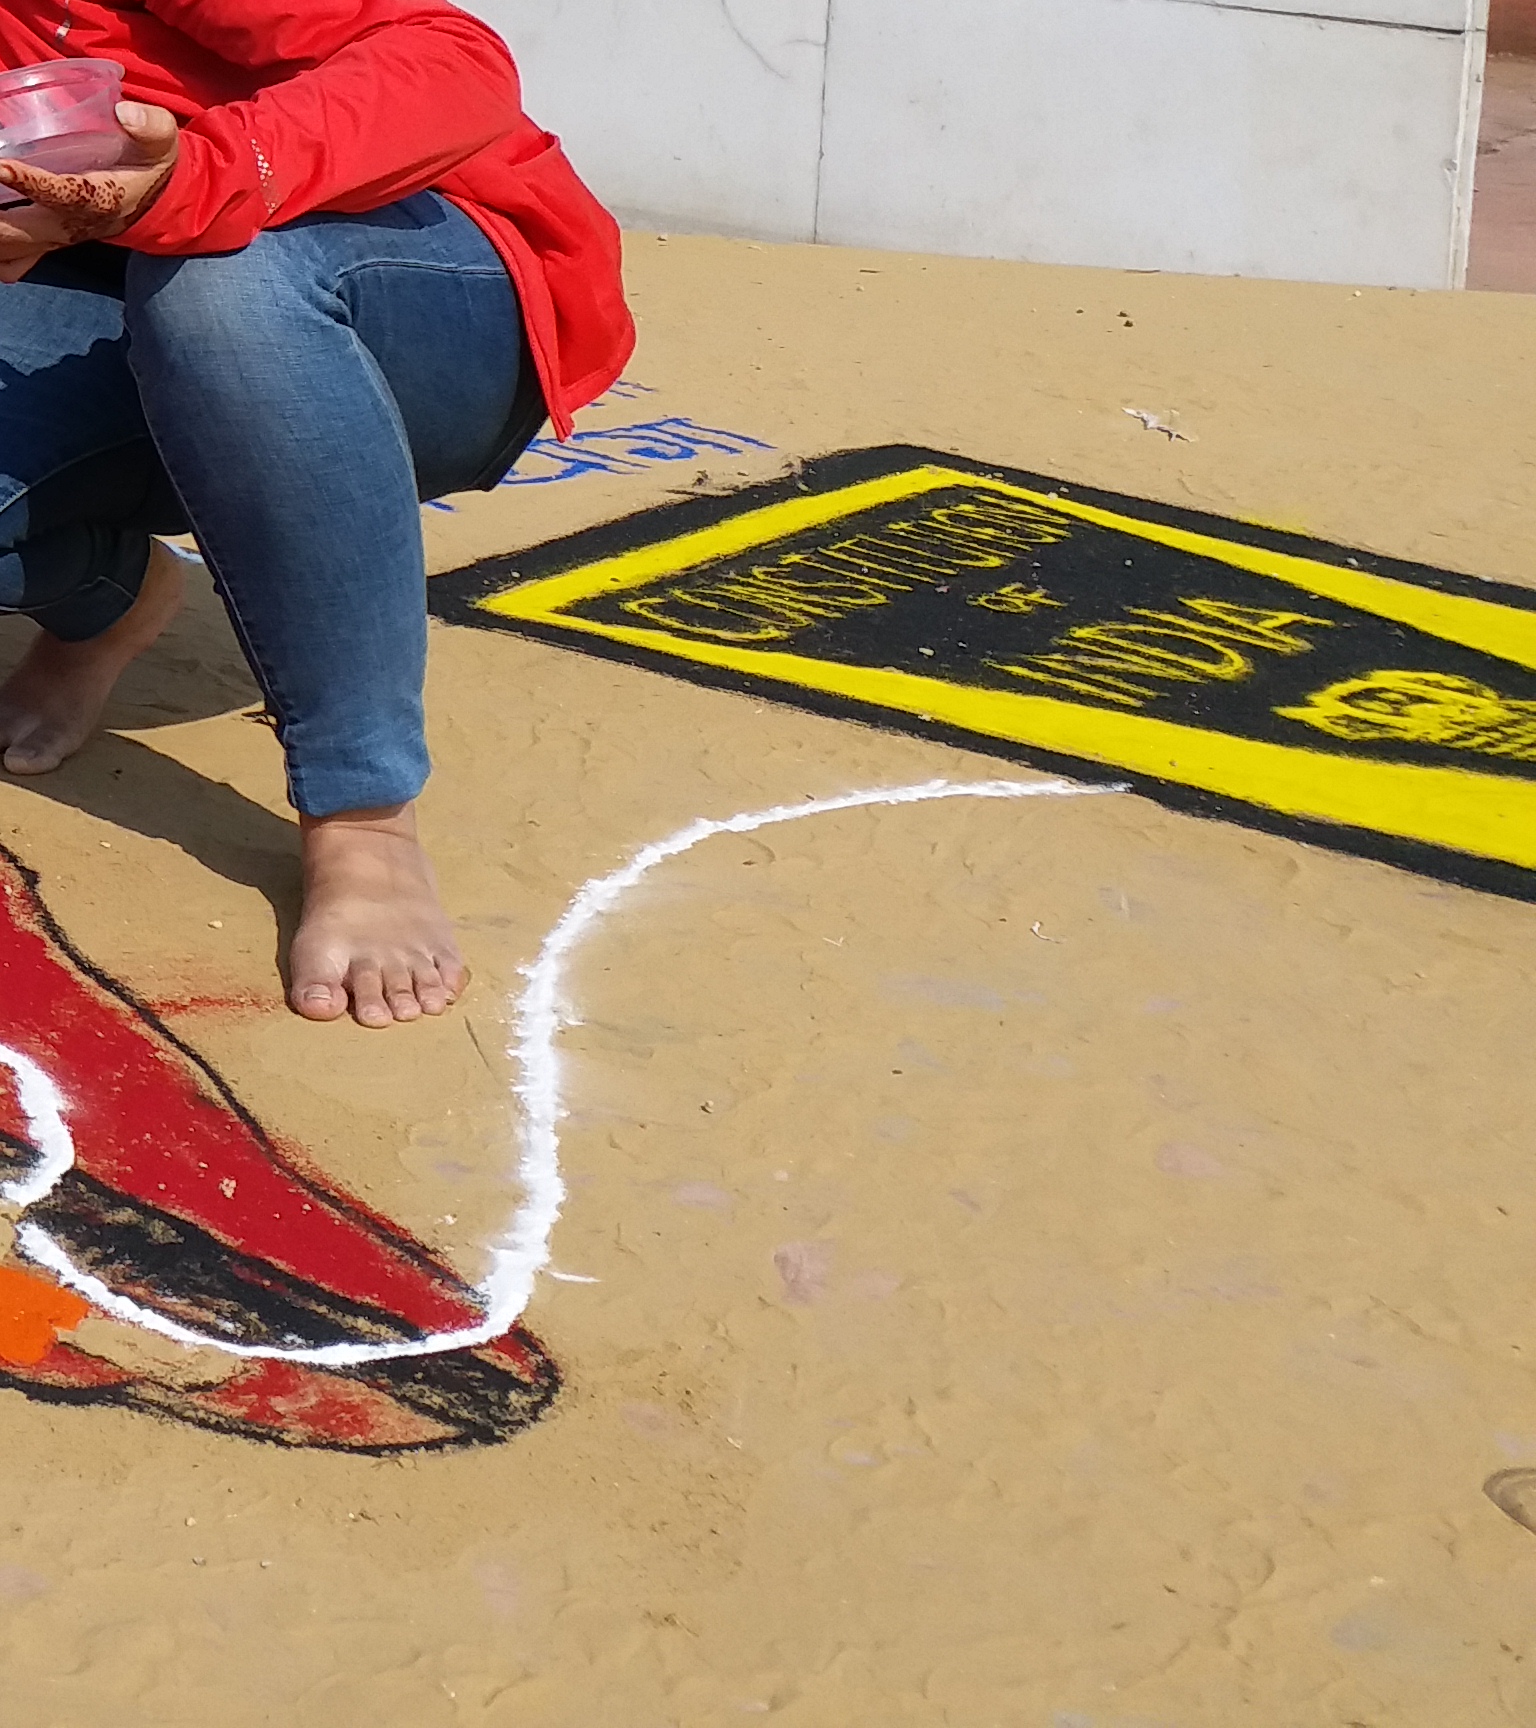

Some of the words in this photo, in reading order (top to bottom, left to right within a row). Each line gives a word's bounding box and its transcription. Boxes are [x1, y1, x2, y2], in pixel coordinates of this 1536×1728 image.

[618, 492, 1076, 644] CONSTITUTION
[966, 582, 1069, 616] OF
[982, 595, 1338, 710] INDIA
